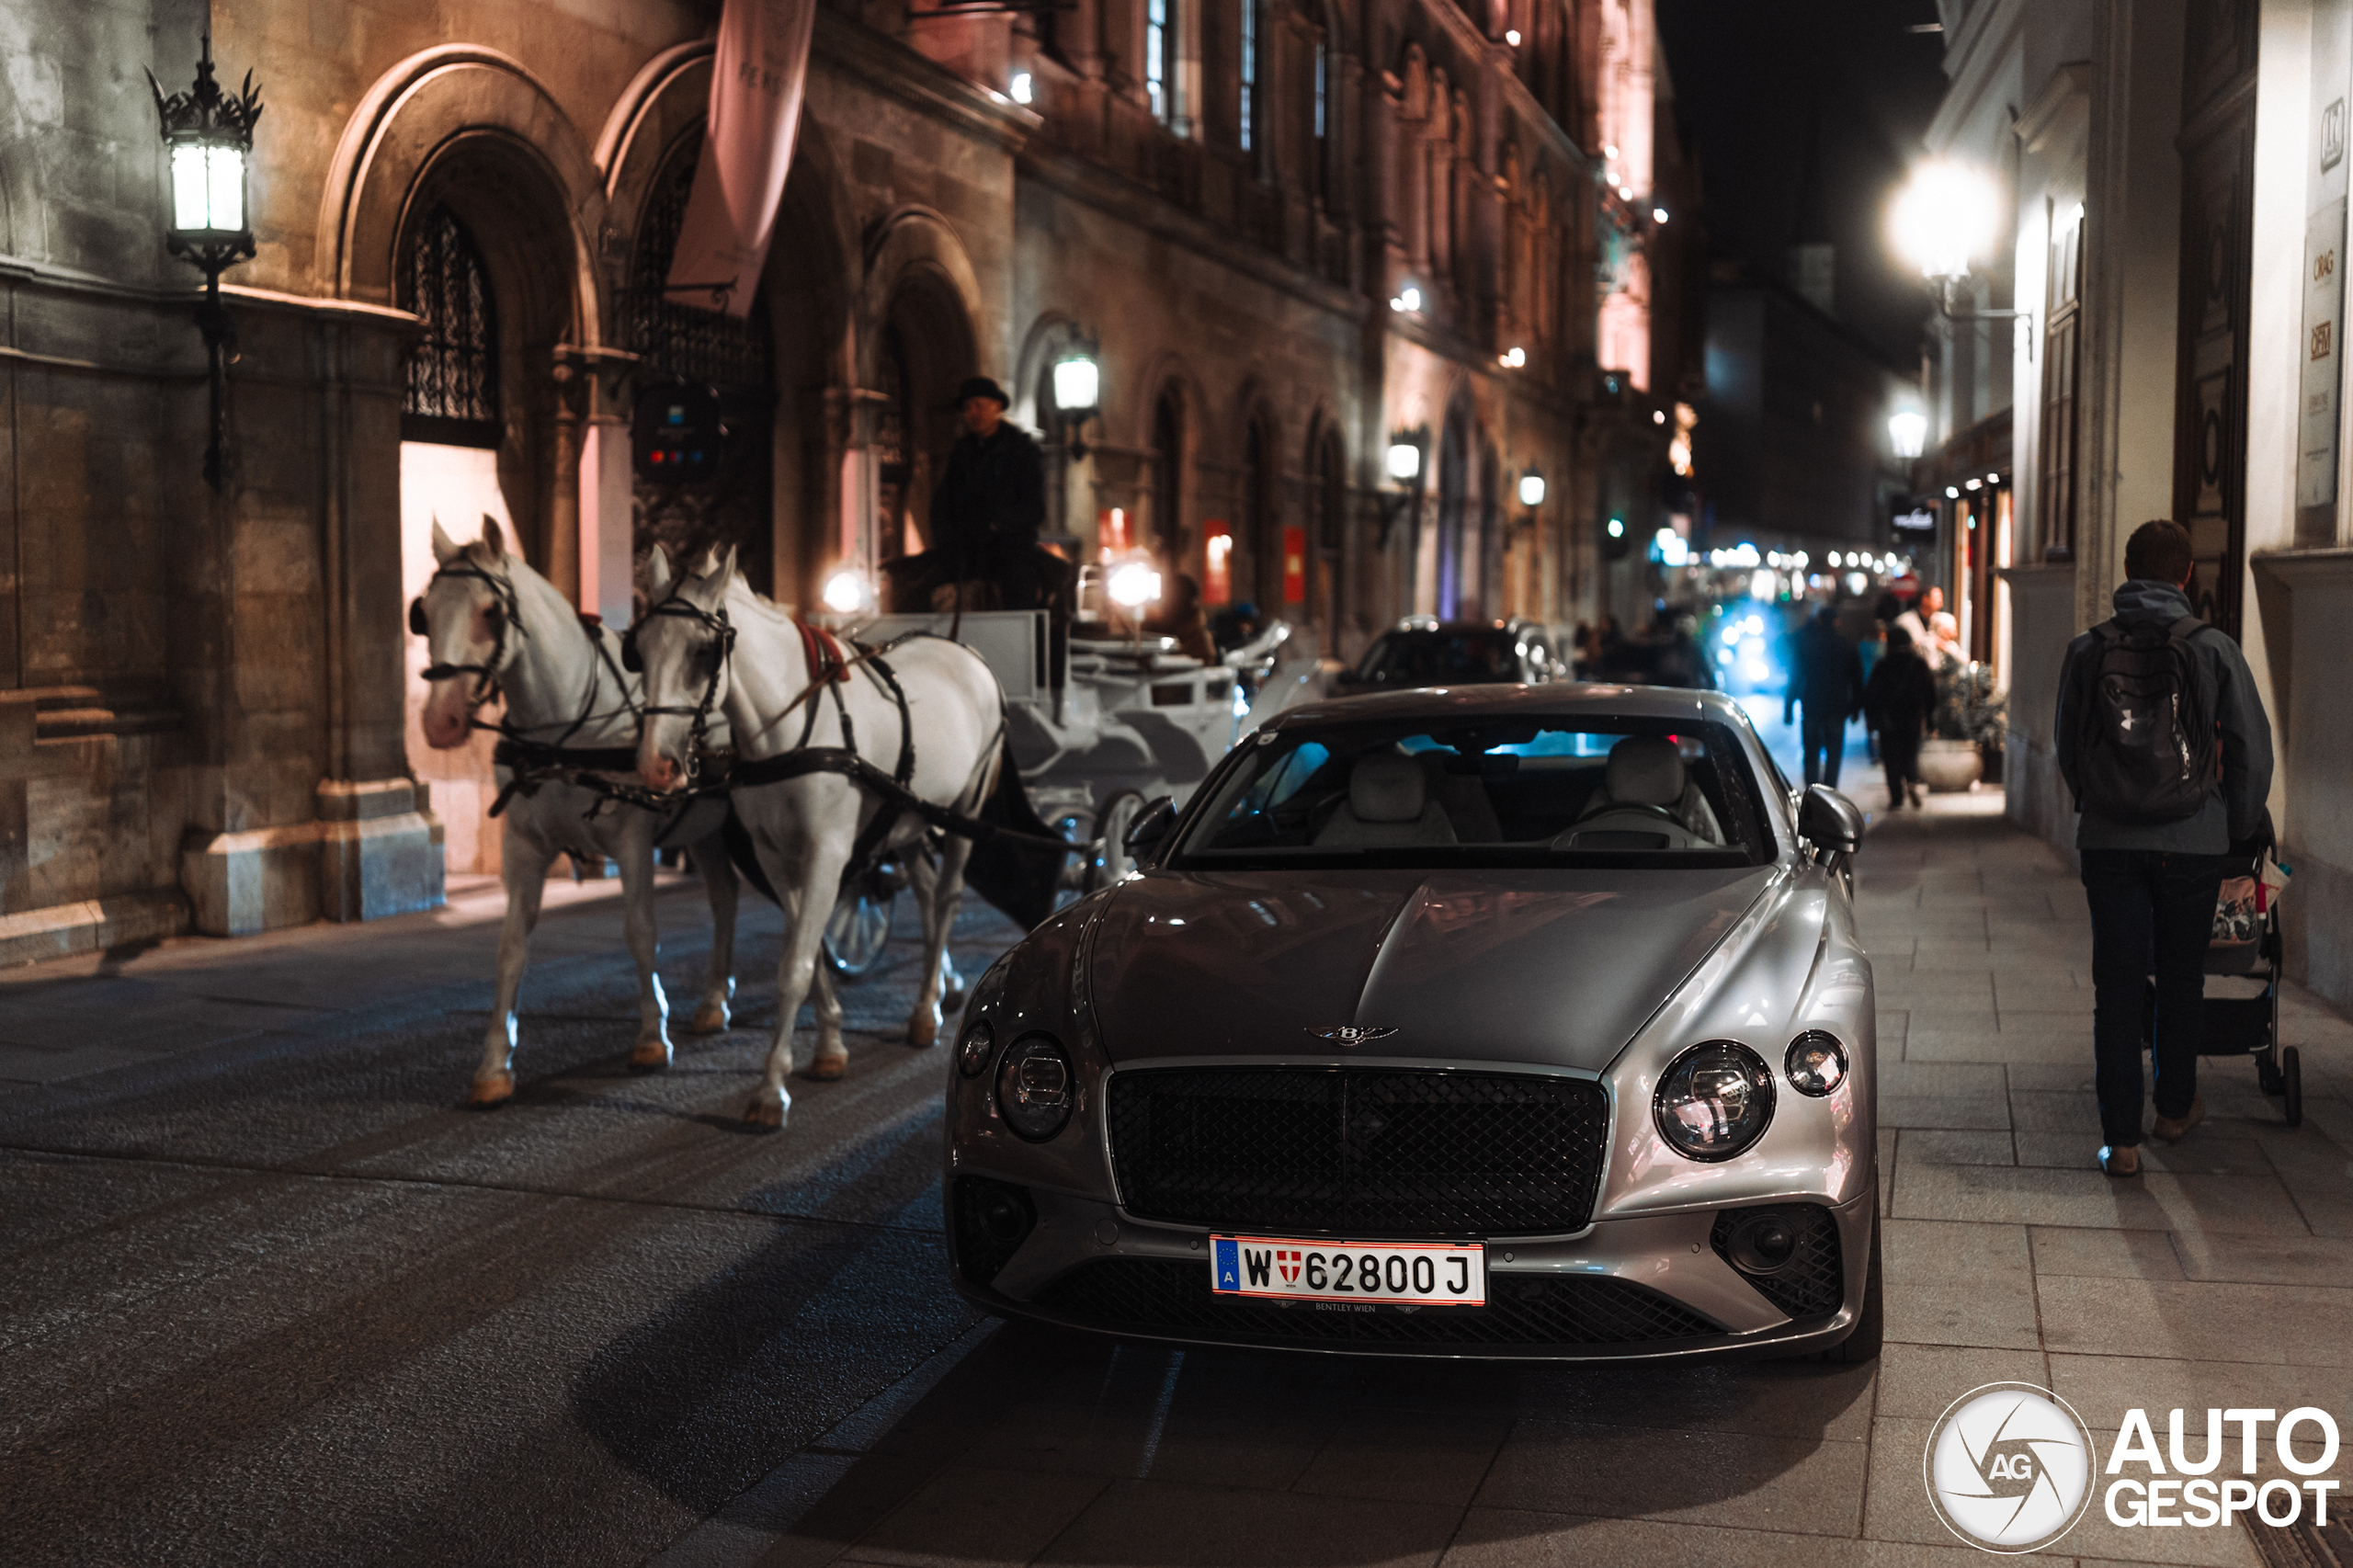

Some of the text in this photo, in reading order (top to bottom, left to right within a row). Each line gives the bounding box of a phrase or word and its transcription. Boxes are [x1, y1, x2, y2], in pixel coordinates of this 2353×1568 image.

[1341, 1028, 1358, 1039] B
[1245, 1248, 1272, 1287] W
[1223, 1271, 1234, 1283] A
[1315, 1302, 1376, 1313] BENTLEY WIEN
